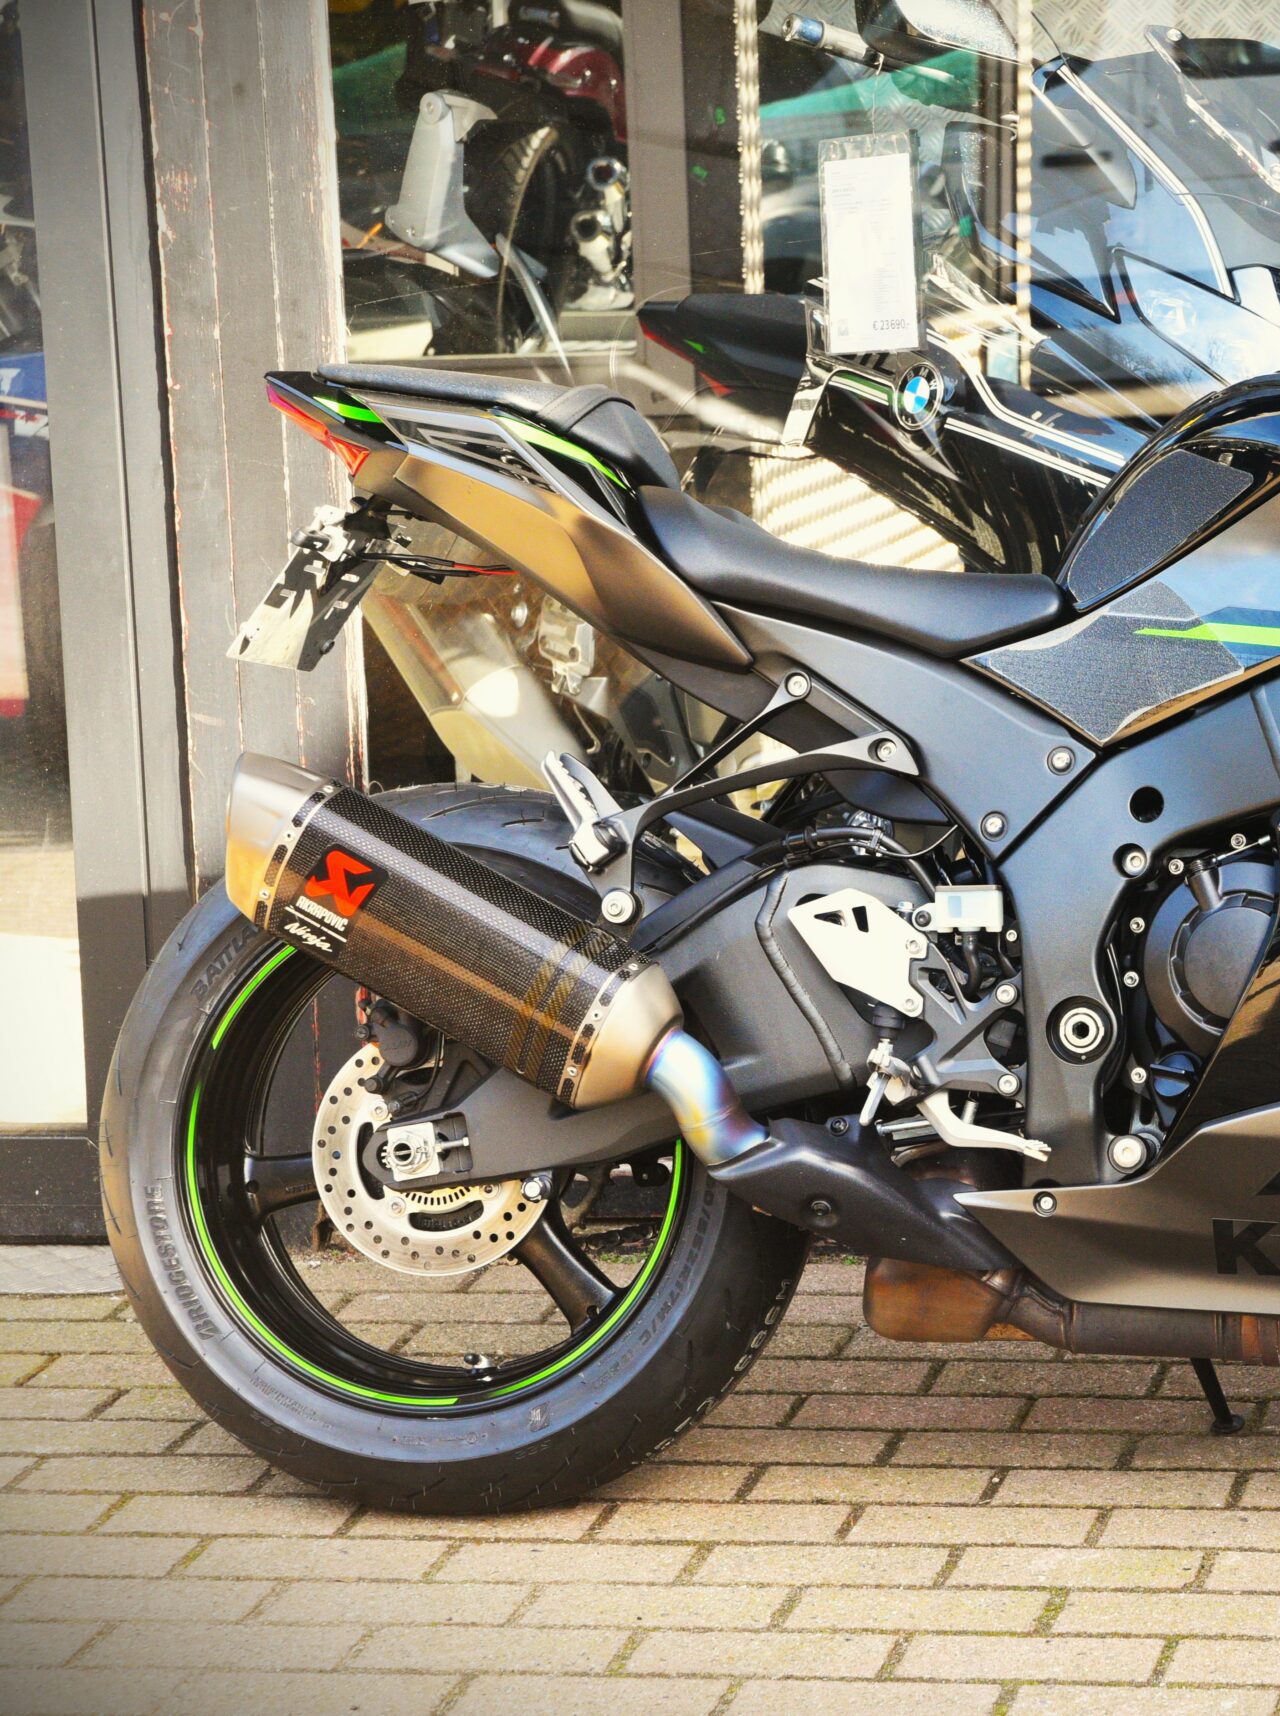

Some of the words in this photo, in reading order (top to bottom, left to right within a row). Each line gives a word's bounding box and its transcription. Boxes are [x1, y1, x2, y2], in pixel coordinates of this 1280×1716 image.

[190, 925, 259, 1000] BATTLA
[284, 922, 333, 953] Ninja
[144, 1183, 222, 1341] BRIDGESTONE
